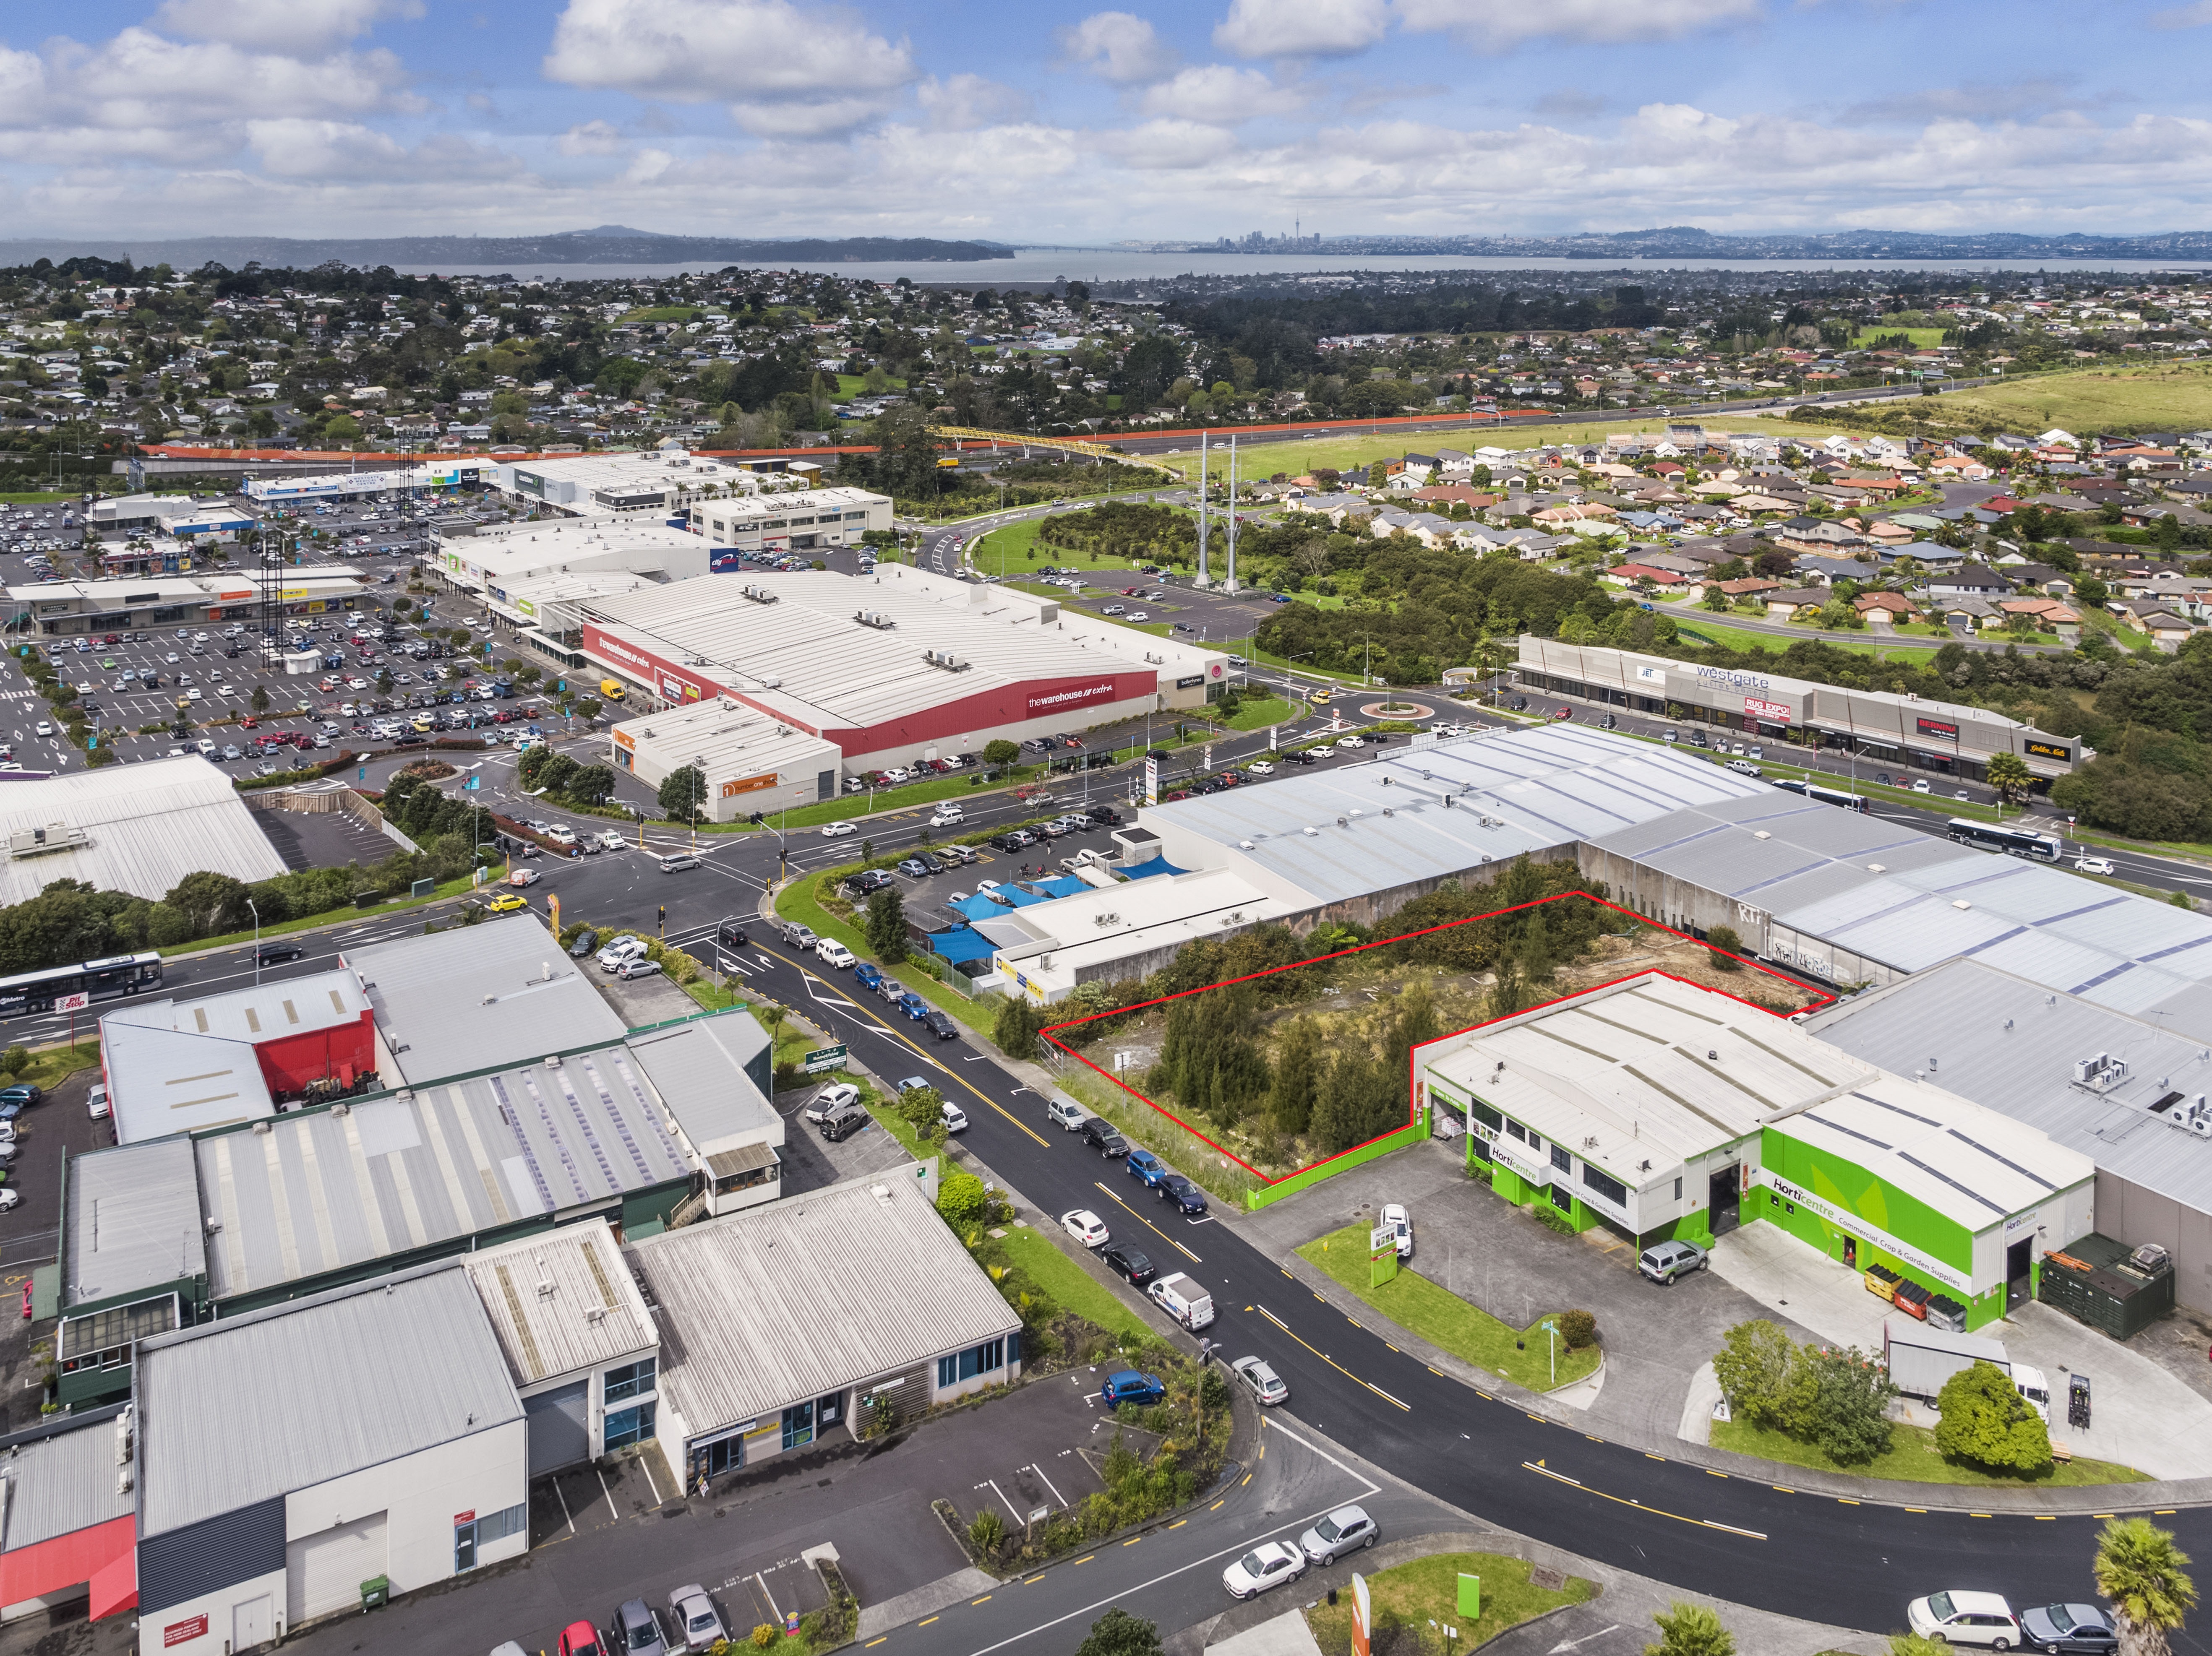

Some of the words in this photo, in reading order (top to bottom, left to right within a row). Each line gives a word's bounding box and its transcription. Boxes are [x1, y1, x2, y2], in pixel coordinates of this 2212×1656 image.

[1642, 668, 1654, 677] JET
[1697, 666, 1769, 689] westgate
[1093, 684, 1113, 695] extra
[1746, 698, 1763, 709] RUG
[1766, 703, 1787, 714] EXPO
[1919, 719, 1956, 732] BERNINA
[65, 1001, 85, 1009] Stop
[1435, 1089, 1445, 1098] Open
[1450, 1098, 1460, 1107] Public
[1492, 1147, 1536, 1181] Horticentre
[1556, 1178, 1580, 1195] Commercal
[1581, 1193, 1591, 1203] Crop
[1595, 1202, 1610, 1215] Garden
[1611, 1211, 1629, 1226] Supplies
[2006, 1212, 2036, 1232] Horticentre
[1774, 1178, 1834, 1219] Horticentre
[1839, 1217, 1878, 1243] Commercial
[1880, 1240, 1896, 1254] Crop
[1904, 1252, 1929, 1271] Garden
[1931, 1266, 1961, 1288] Supplies
